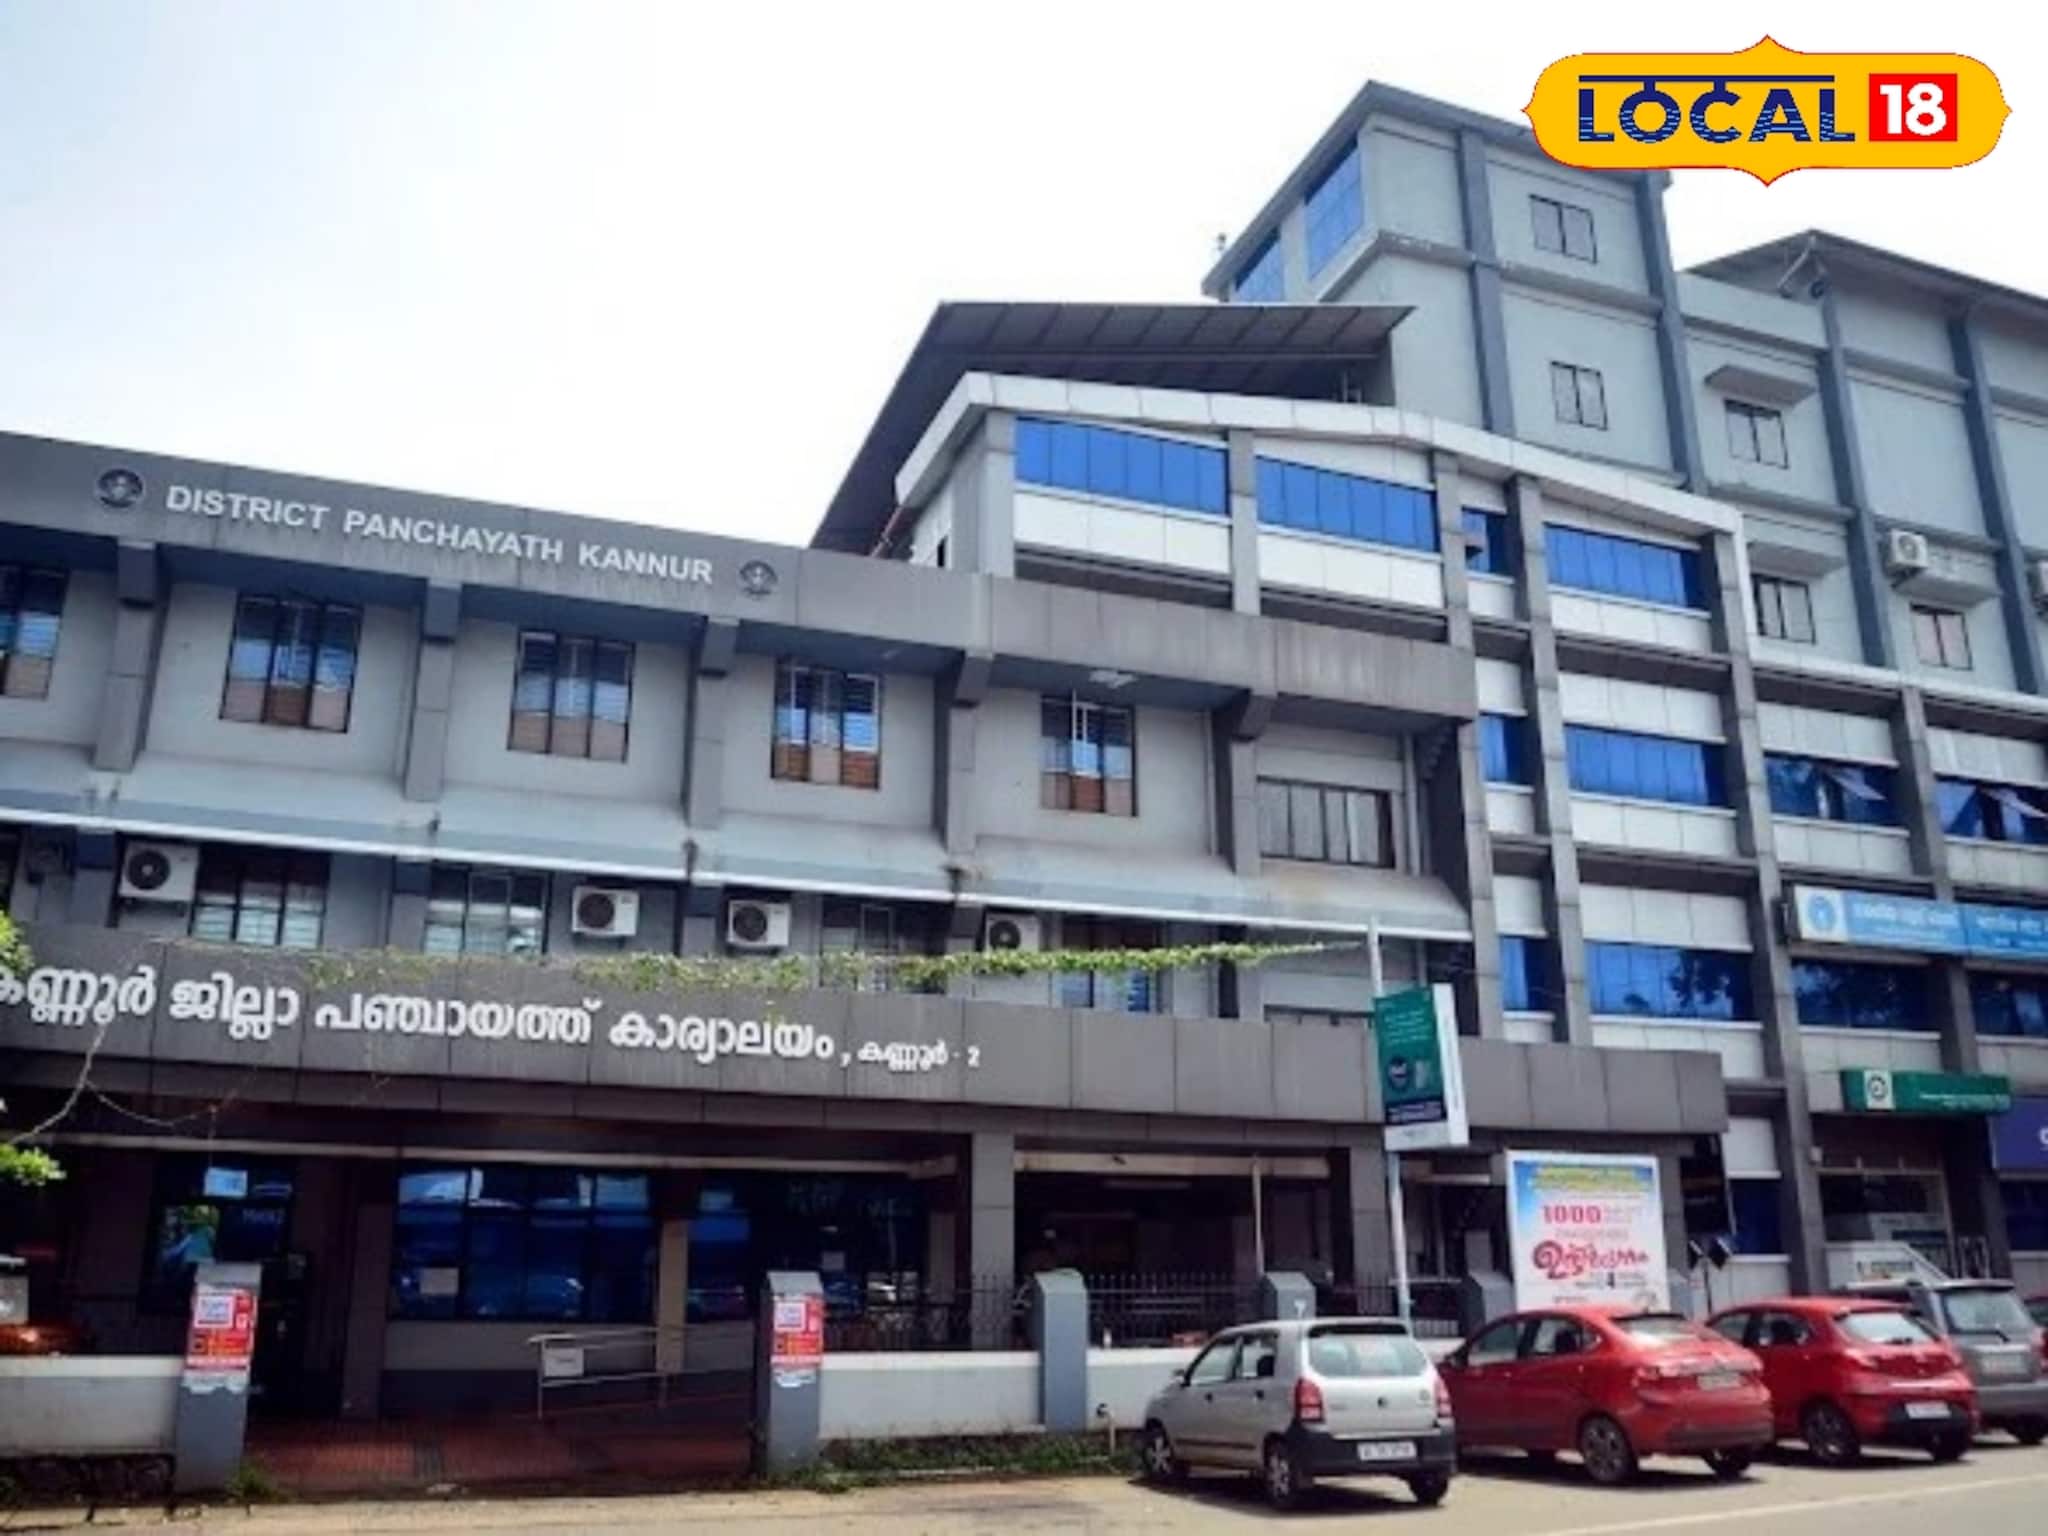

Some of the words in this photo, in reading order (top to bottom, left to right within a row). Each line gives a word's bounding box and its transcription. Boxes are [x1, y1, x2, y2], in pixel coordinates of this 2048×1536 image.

[166, 485, 330, 531] DISTRICT
[343, 510, 563, 564] PANCHAYATH
[578, 541, 713, 584] KANNUR
[169, 970, 300, 1042] ജില്ലാ
[314, 991, 603, 1044] പഞ്ചായത്ത്
[967, 1045, 981, 1068] 2
[1543, 1204, 1602, 1224] 1000
